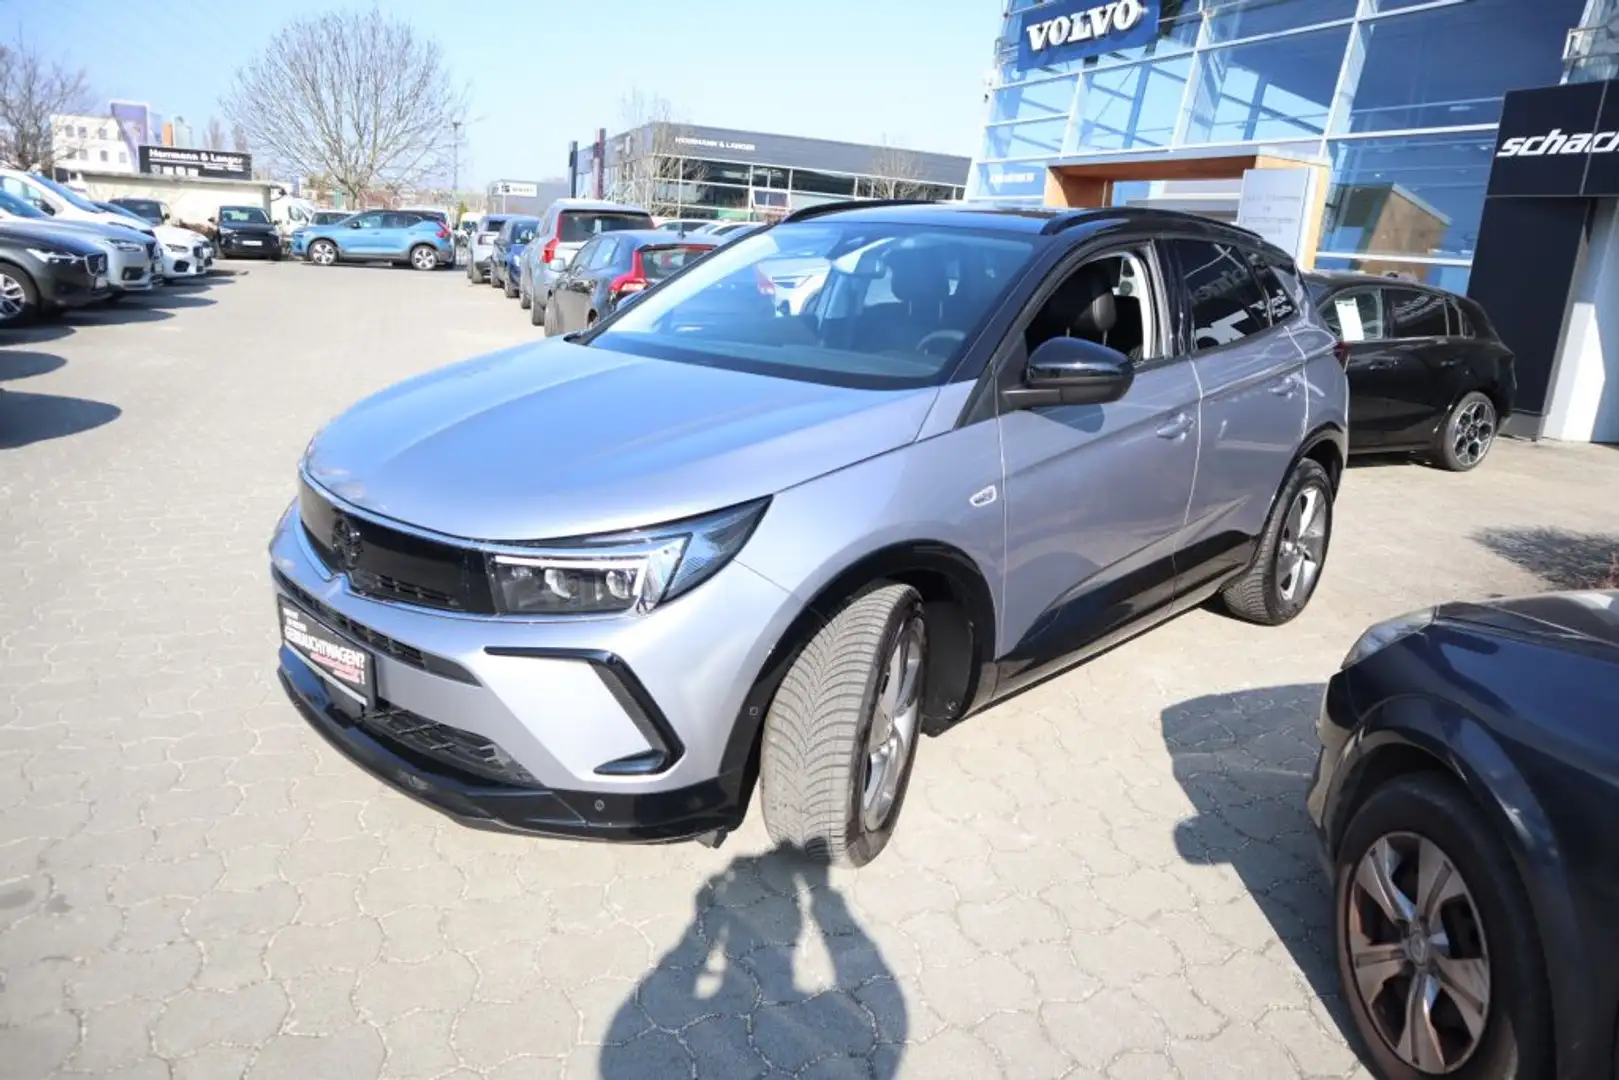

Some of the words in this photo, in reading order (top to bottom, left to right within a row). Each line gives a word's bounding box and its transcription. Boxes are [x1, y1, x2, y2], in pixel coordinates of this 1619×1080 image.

[1026, 0, 1140, 51] VOLVO
[201, 153, 208, 161] &
[1496, 128, 1619, 157] schac
